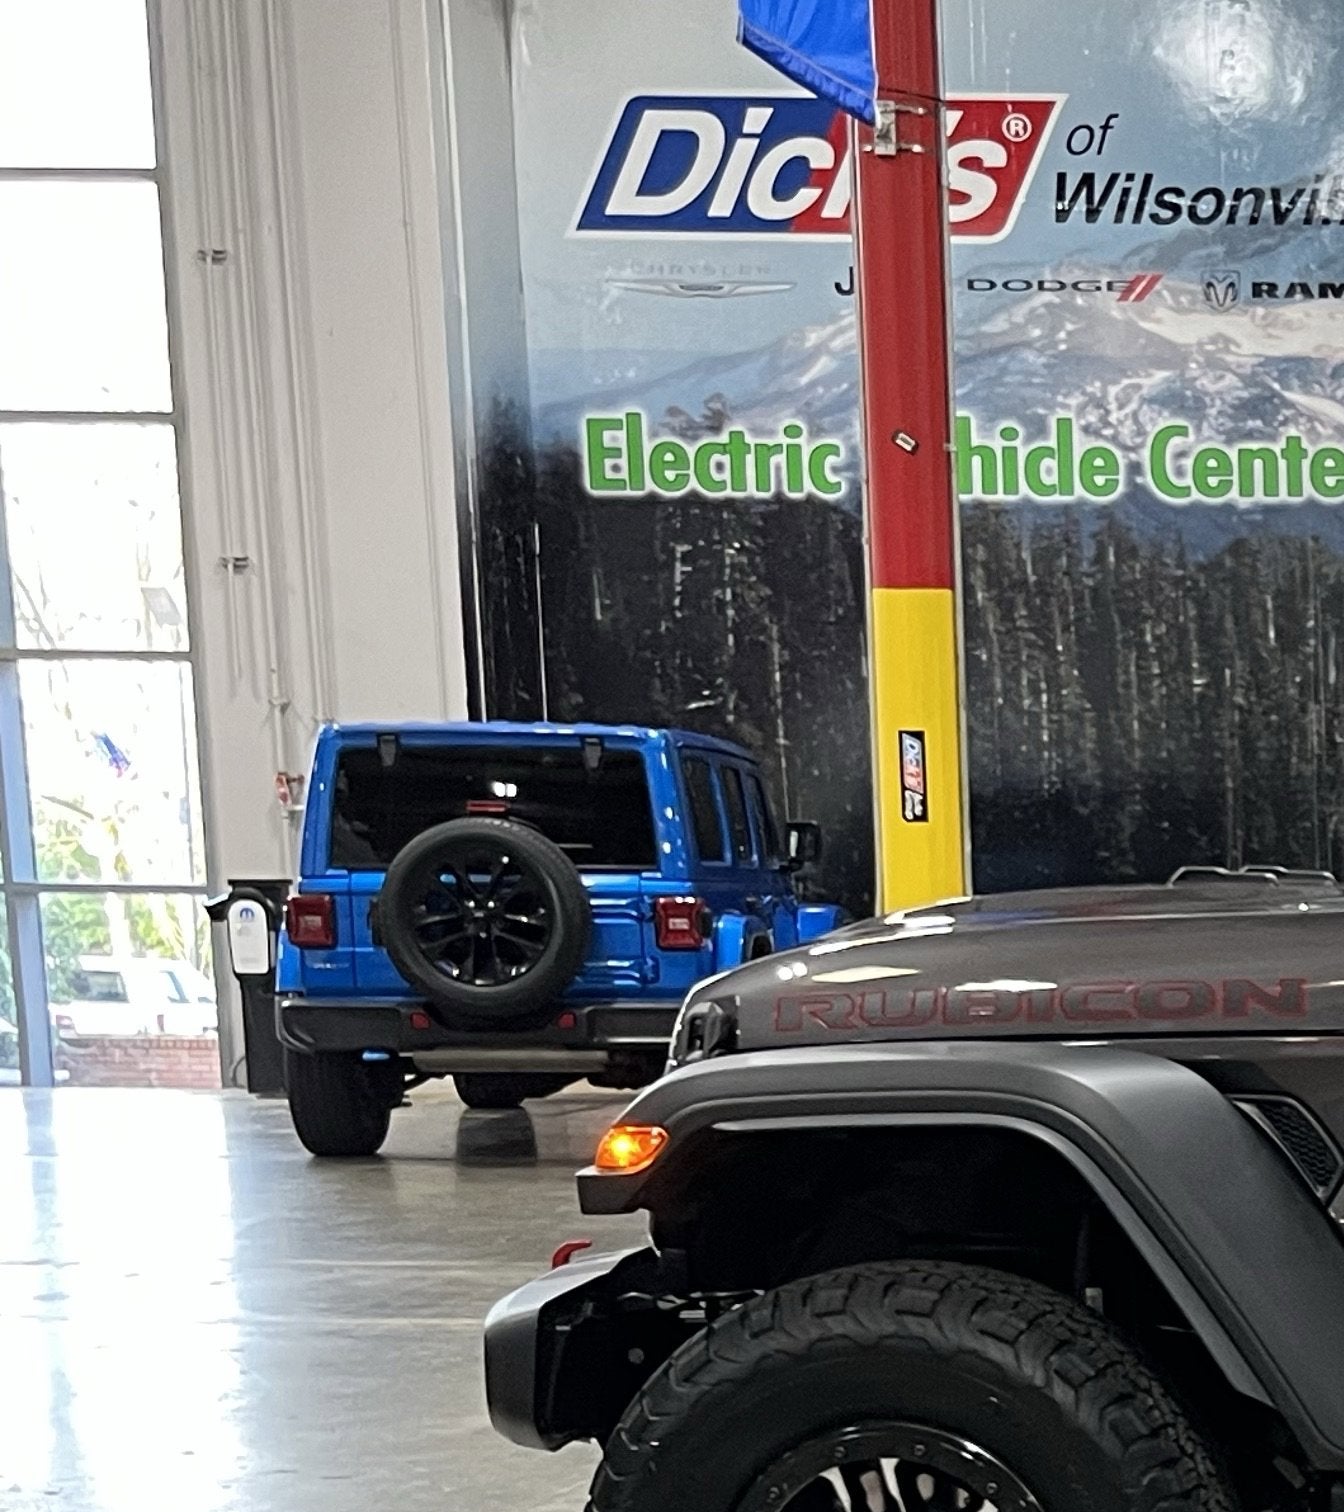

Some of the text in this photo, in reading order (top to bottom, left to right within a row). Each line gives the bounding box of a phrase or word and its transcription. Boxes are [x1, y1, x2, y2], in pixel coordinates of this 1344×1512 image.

[1066, 113, 1119, 156] of
[967, 278, 1132, 292] DODGE
[586, 412, 843, 494] Electric
[956, 416, 1120, 497] hicle
[773, 977, 1309, 1032] RUBICON
